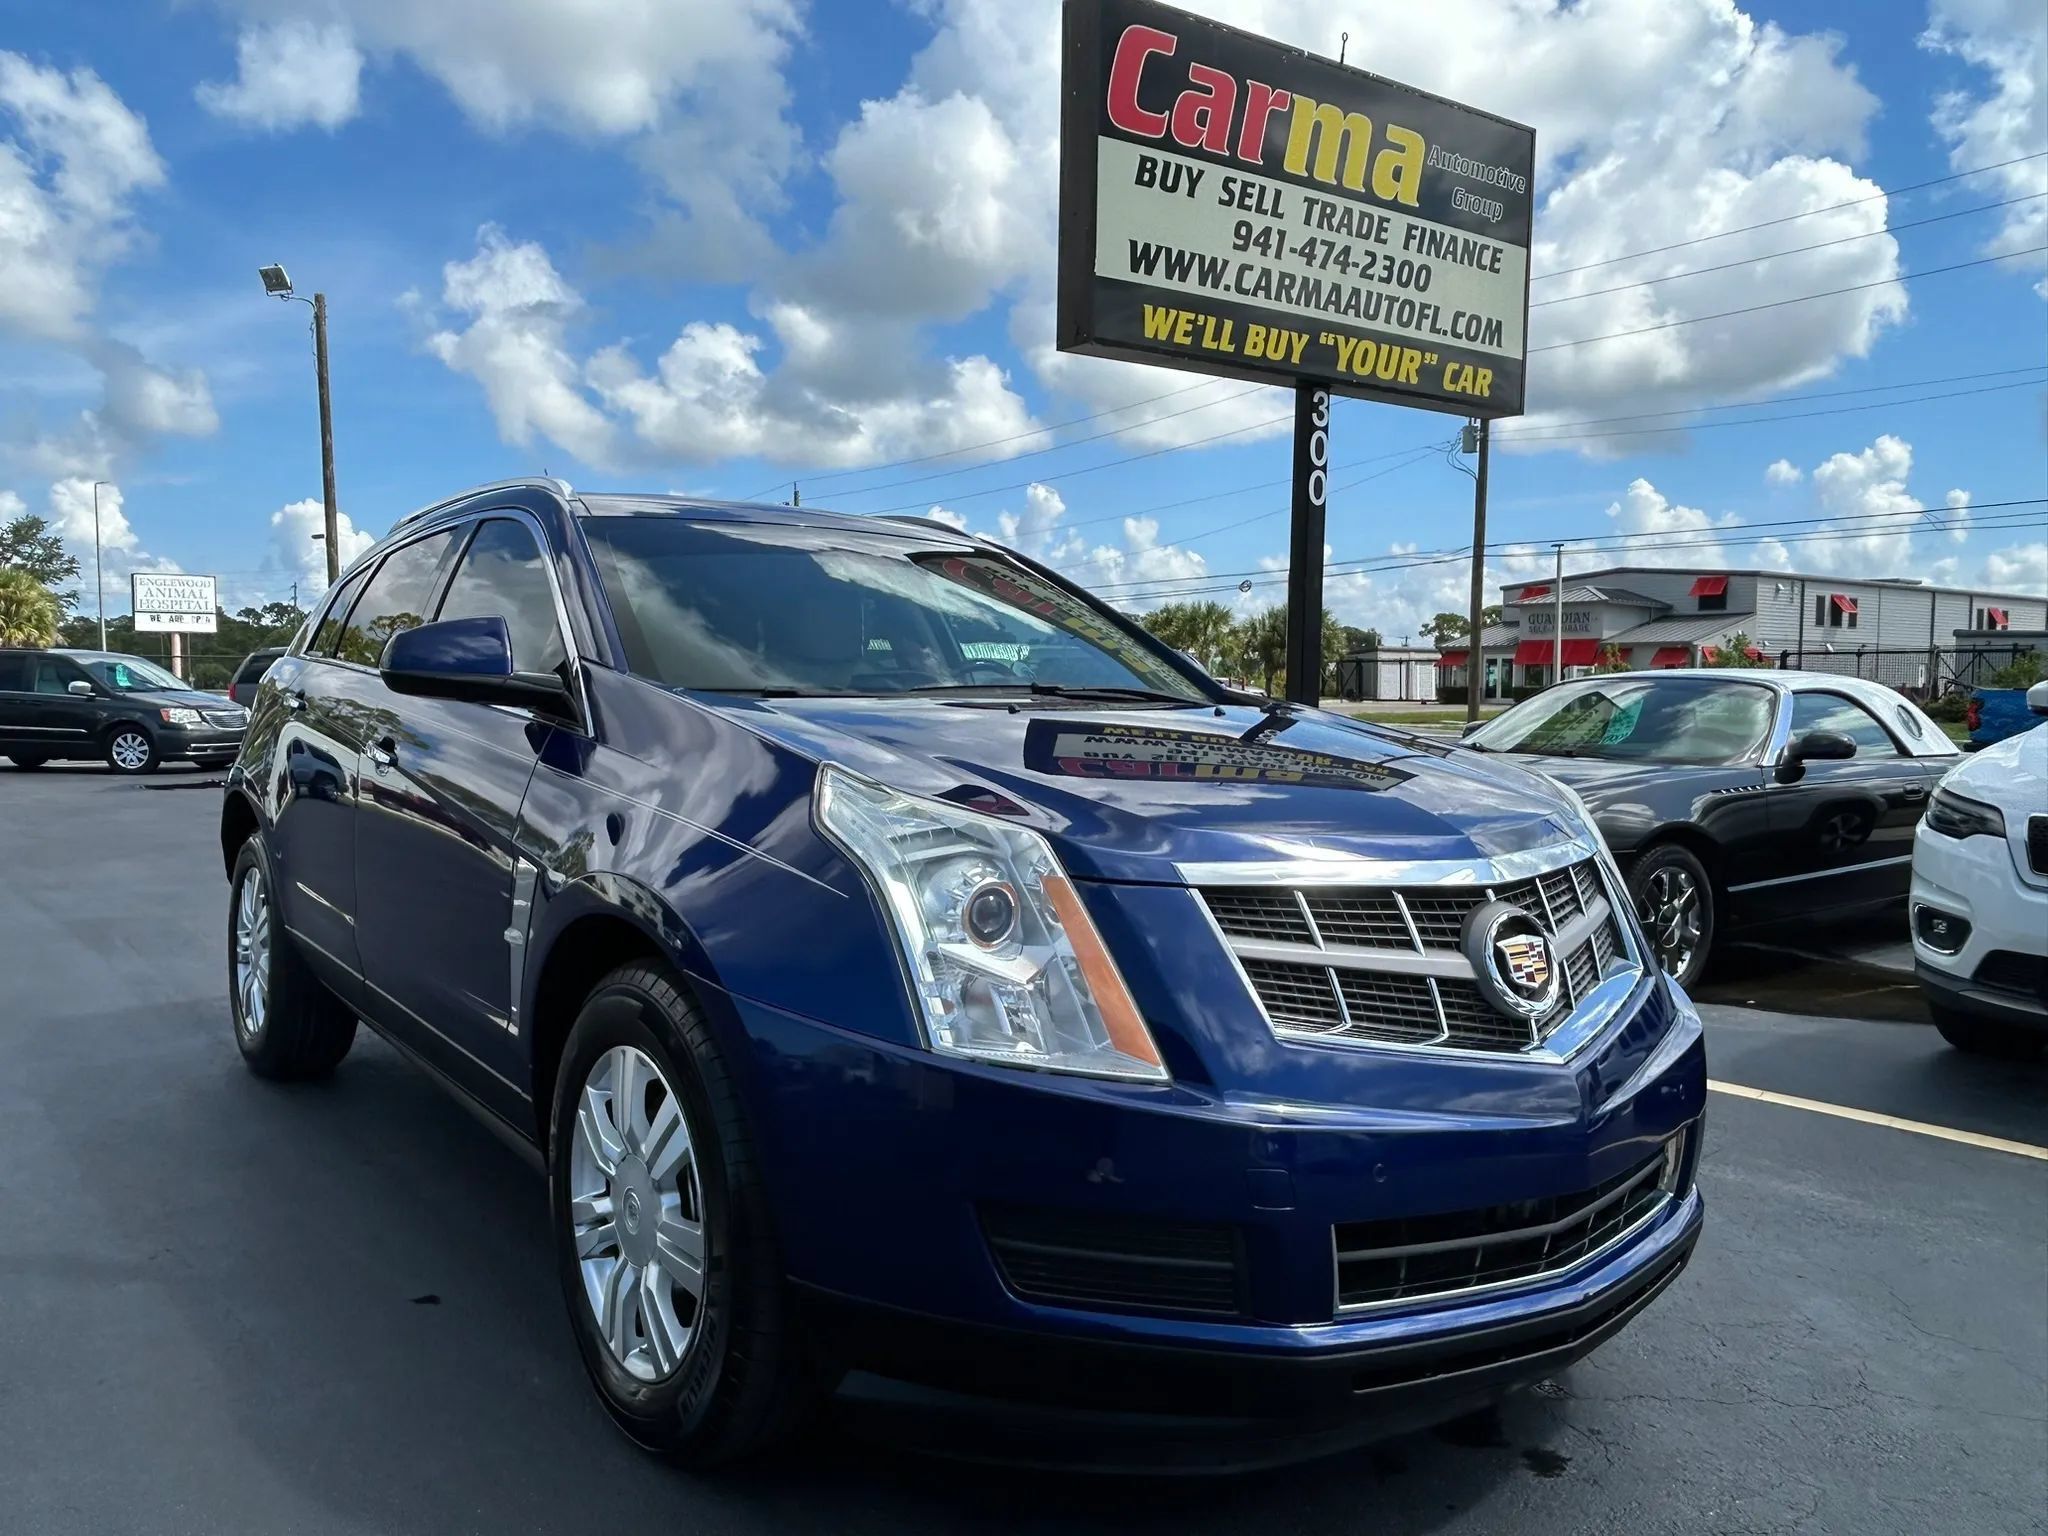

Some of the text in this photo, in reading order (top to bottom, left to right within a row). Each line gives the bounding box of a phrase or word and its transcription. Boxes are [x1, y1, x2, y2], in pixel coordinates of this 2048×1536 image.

[1107, 24, 1425, 207] Carma
[1427, 145, 1525, 194] Automotive
[1134, 154, 1504, 274] BUY SELL TRADE FINANCE
[1452, 187, 1503, 222] Group
[1232, 220, 1432, 292] 941-474-2300
[1128, 239, 1503, 348] WWW.CARMAAUTOFL.COM
[1143, 304, 1236, 352] WE'LL
[1243, 323, 1310, 365] BUY
[1442, 362, 1493, 397] CAR
[1308, 390, 1330, 507] 300
[139, 577, 211, 588] ENGLEWOOD
[139, 599, 214, 611] HOSPITAL
[144, 588, 208, 600] ANIMAL
[1528, 611, 1591, 625] GUADIAN
